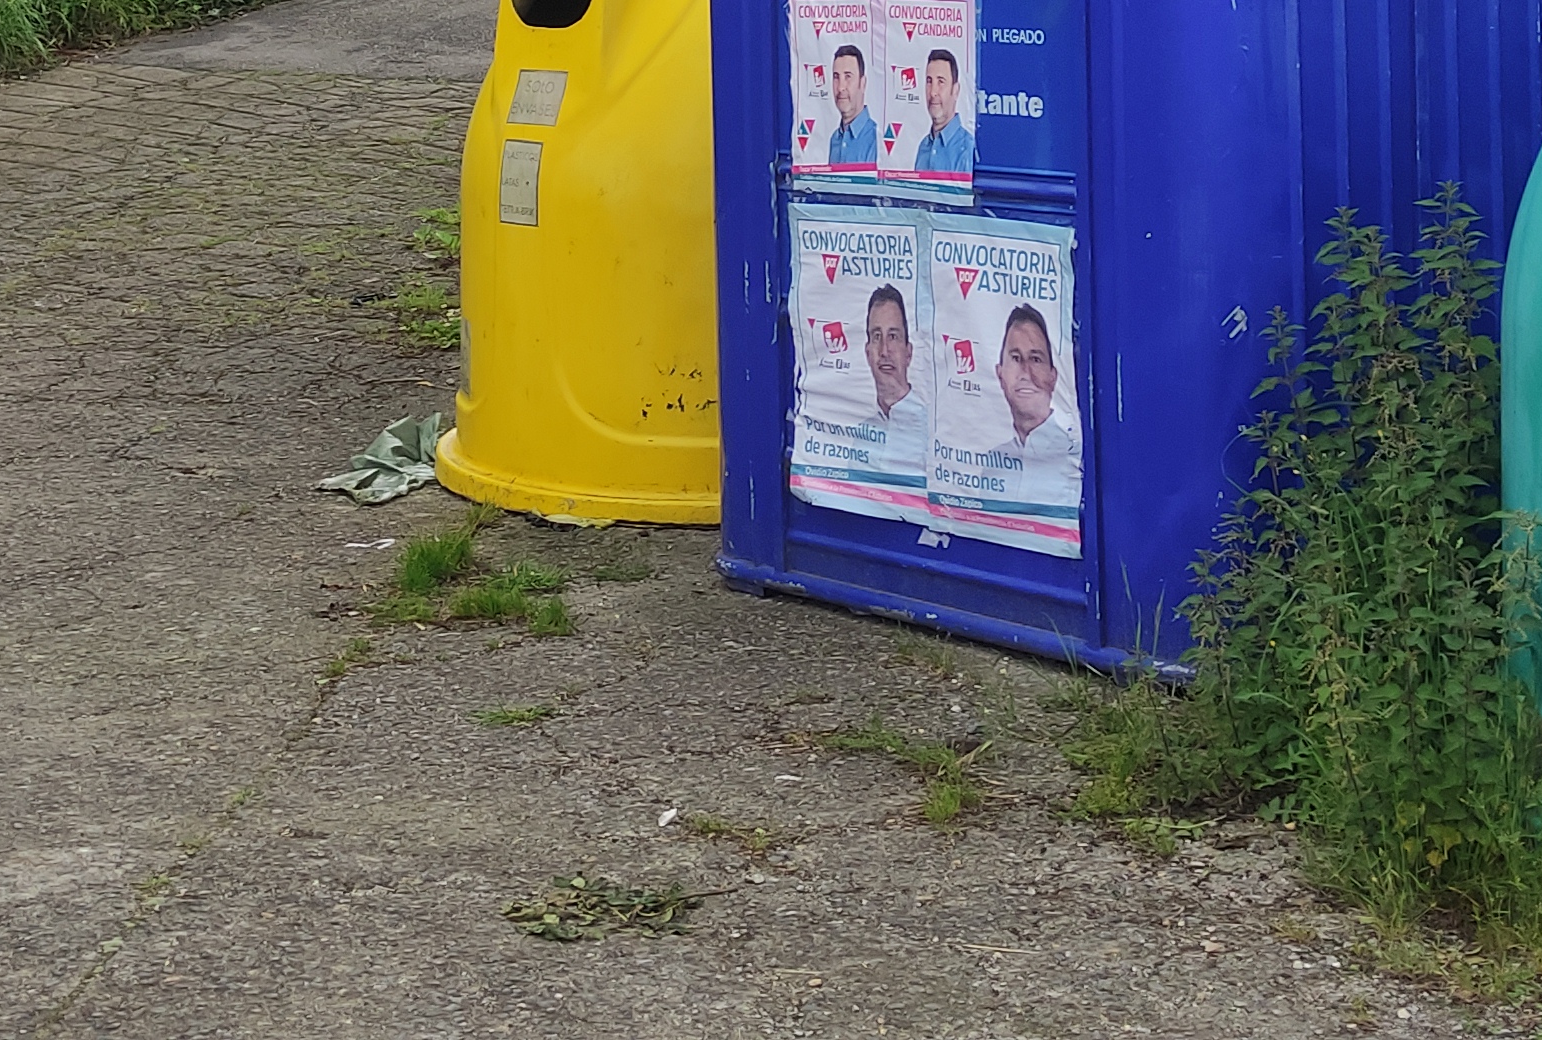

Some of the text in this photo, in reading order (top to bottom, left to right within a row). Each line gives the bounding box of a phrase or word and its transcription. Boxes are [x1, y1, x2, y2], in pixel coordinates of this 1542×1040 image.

[798, 4, 868, 19] CONVOCATORIA
[888, 5, 963, 22] CONVOCATORIA
[825, 21, 868, 34] CANDAMO
[917, 23, 963, 39] CANDAMO
[992, 28, 1045, 45] PLEGADO
[525, 80, 555, 94] SOLO
[802, 229, 913, 257] CONVOCATORIA
[841, 255, 913, 280] ASTURIES
[934, 241, 1058, 277] CONVOCATORIA
[959, 270, 1057, 301] por ASTURIES
[803, 414, 886, 444] Por un millón
[804, 435, 869, 464] de razones
[934, 439, 1023, 471] Por un millón
[935, 463, 1005, 492] de razones
